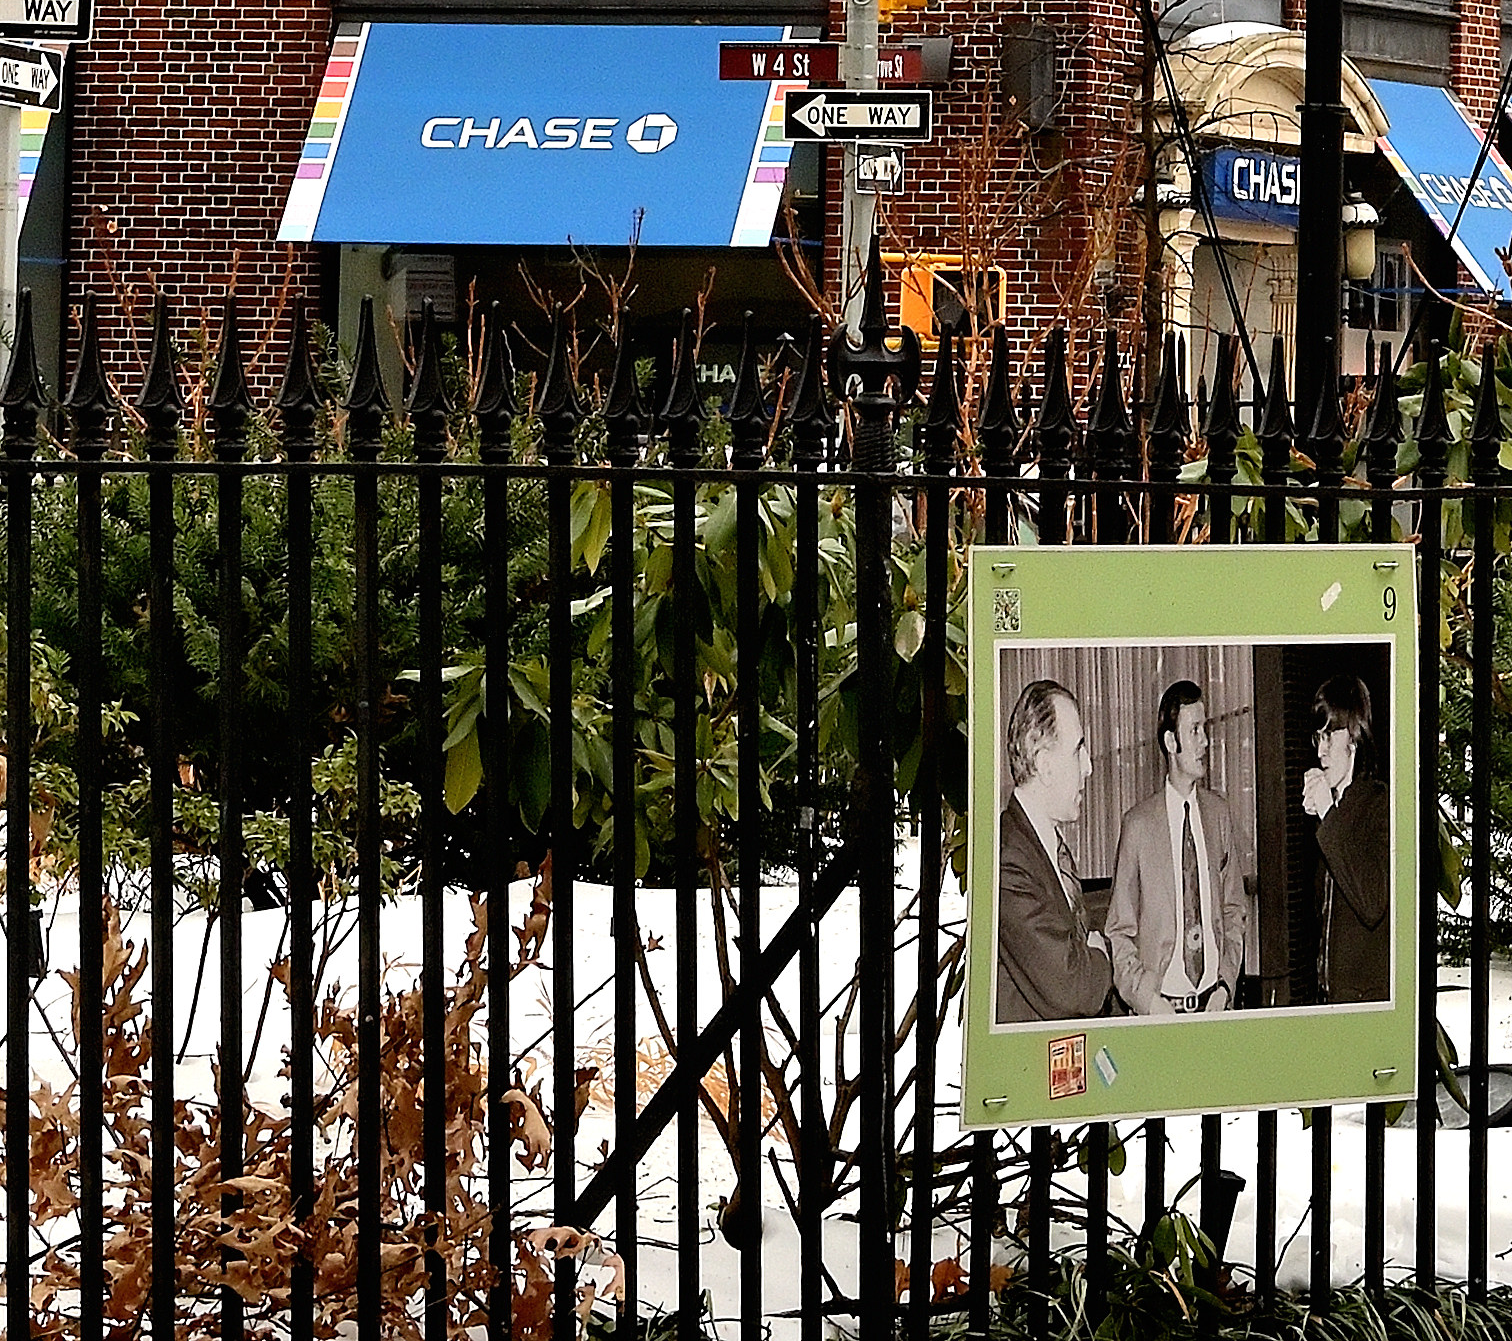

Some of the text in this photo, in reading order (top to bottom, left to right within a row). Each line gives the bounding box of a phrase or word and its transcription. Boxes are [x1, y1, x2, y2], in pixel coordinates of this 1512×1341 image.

[1, 61, 50, 90] ONE WAY
[751, 52, 811, 77] W 4 St
[807, 106, 911, 126] ONE WAY
[419, 117, 621, 151] CHASE
[1382, 585, 1397, 623] 9
